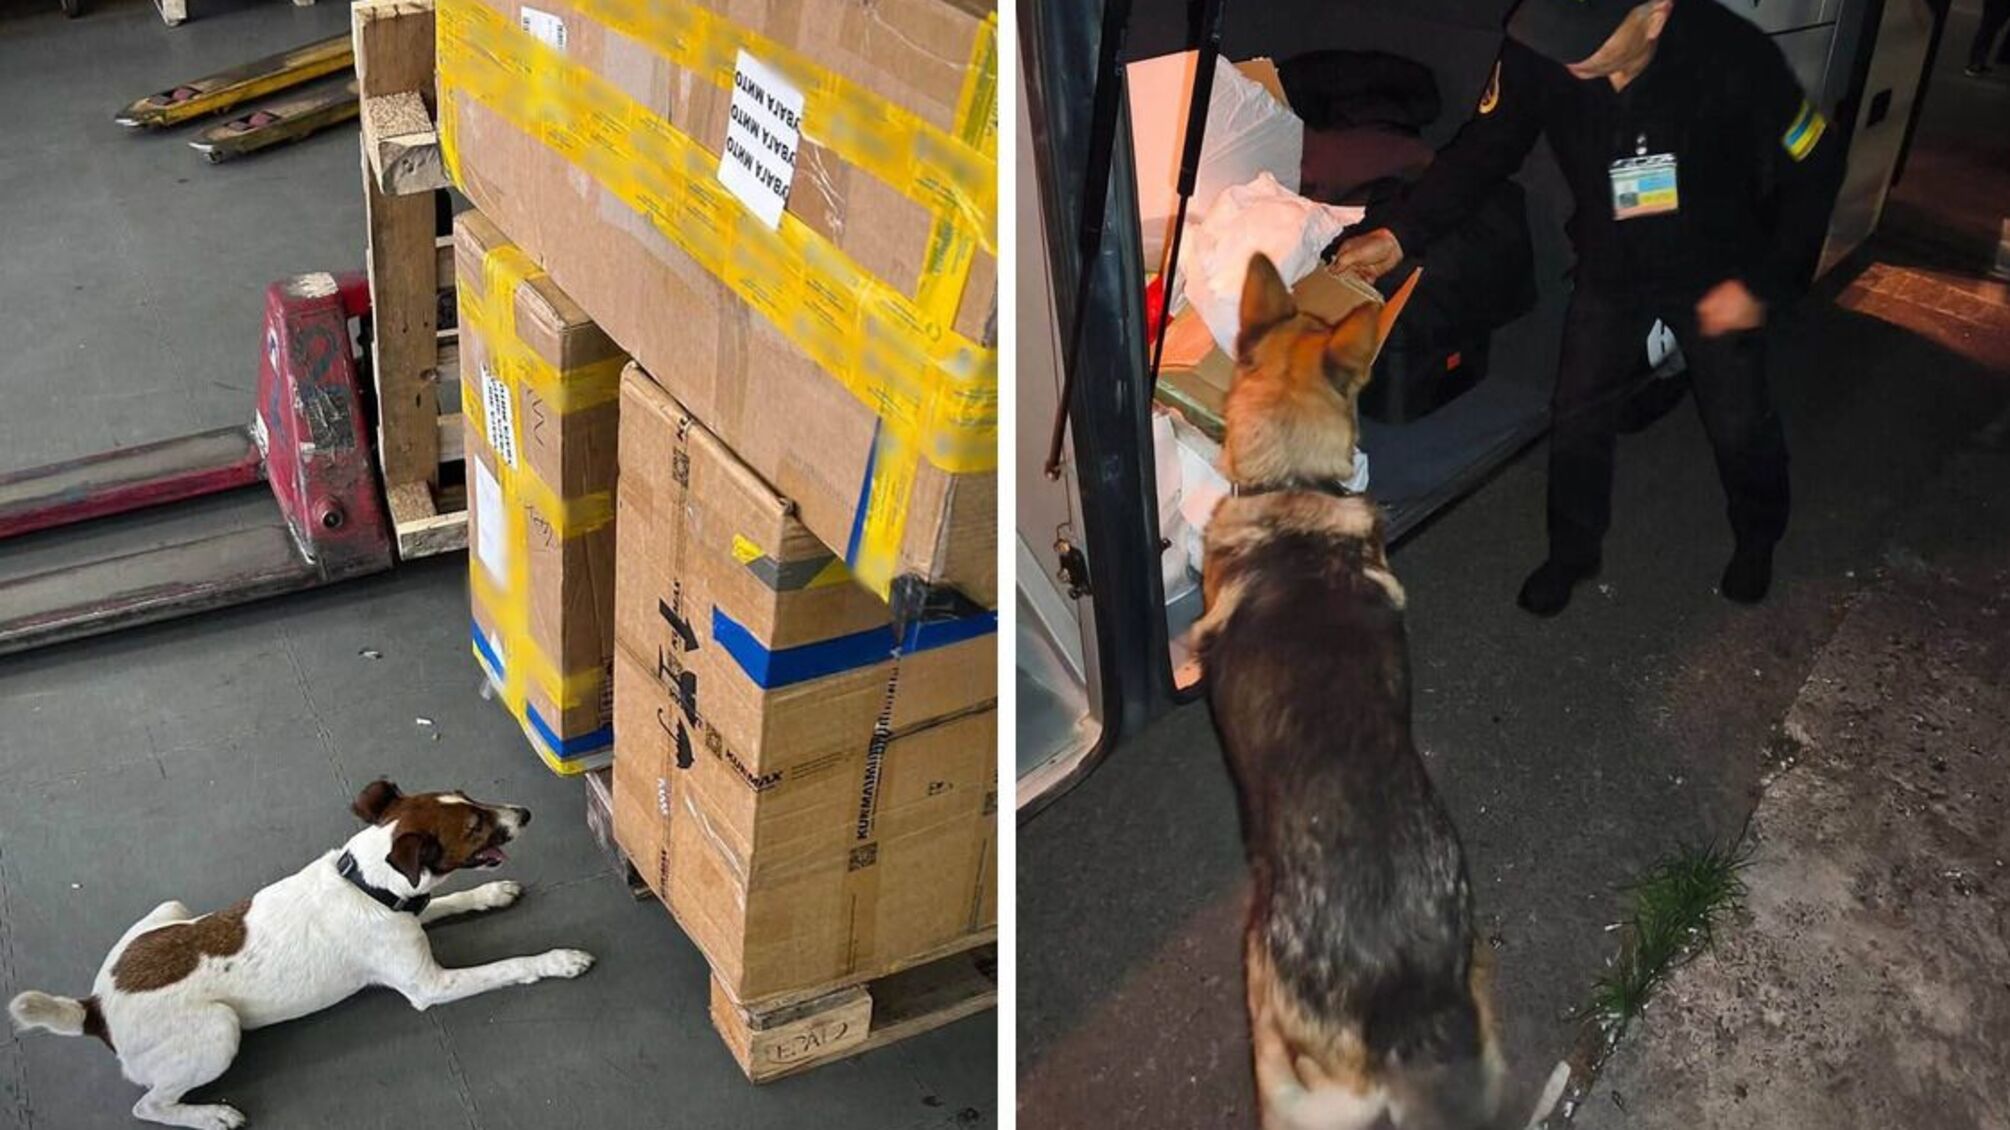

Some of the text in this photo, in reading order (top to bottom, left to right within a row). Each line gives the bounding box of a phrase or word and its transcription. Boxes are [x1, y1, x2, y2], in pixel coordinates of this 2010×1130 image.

[735, 71, 765, 105] МИТО
[730, 104, 761, 138] МИТО
[726, 136, 754, 171] МИТО
